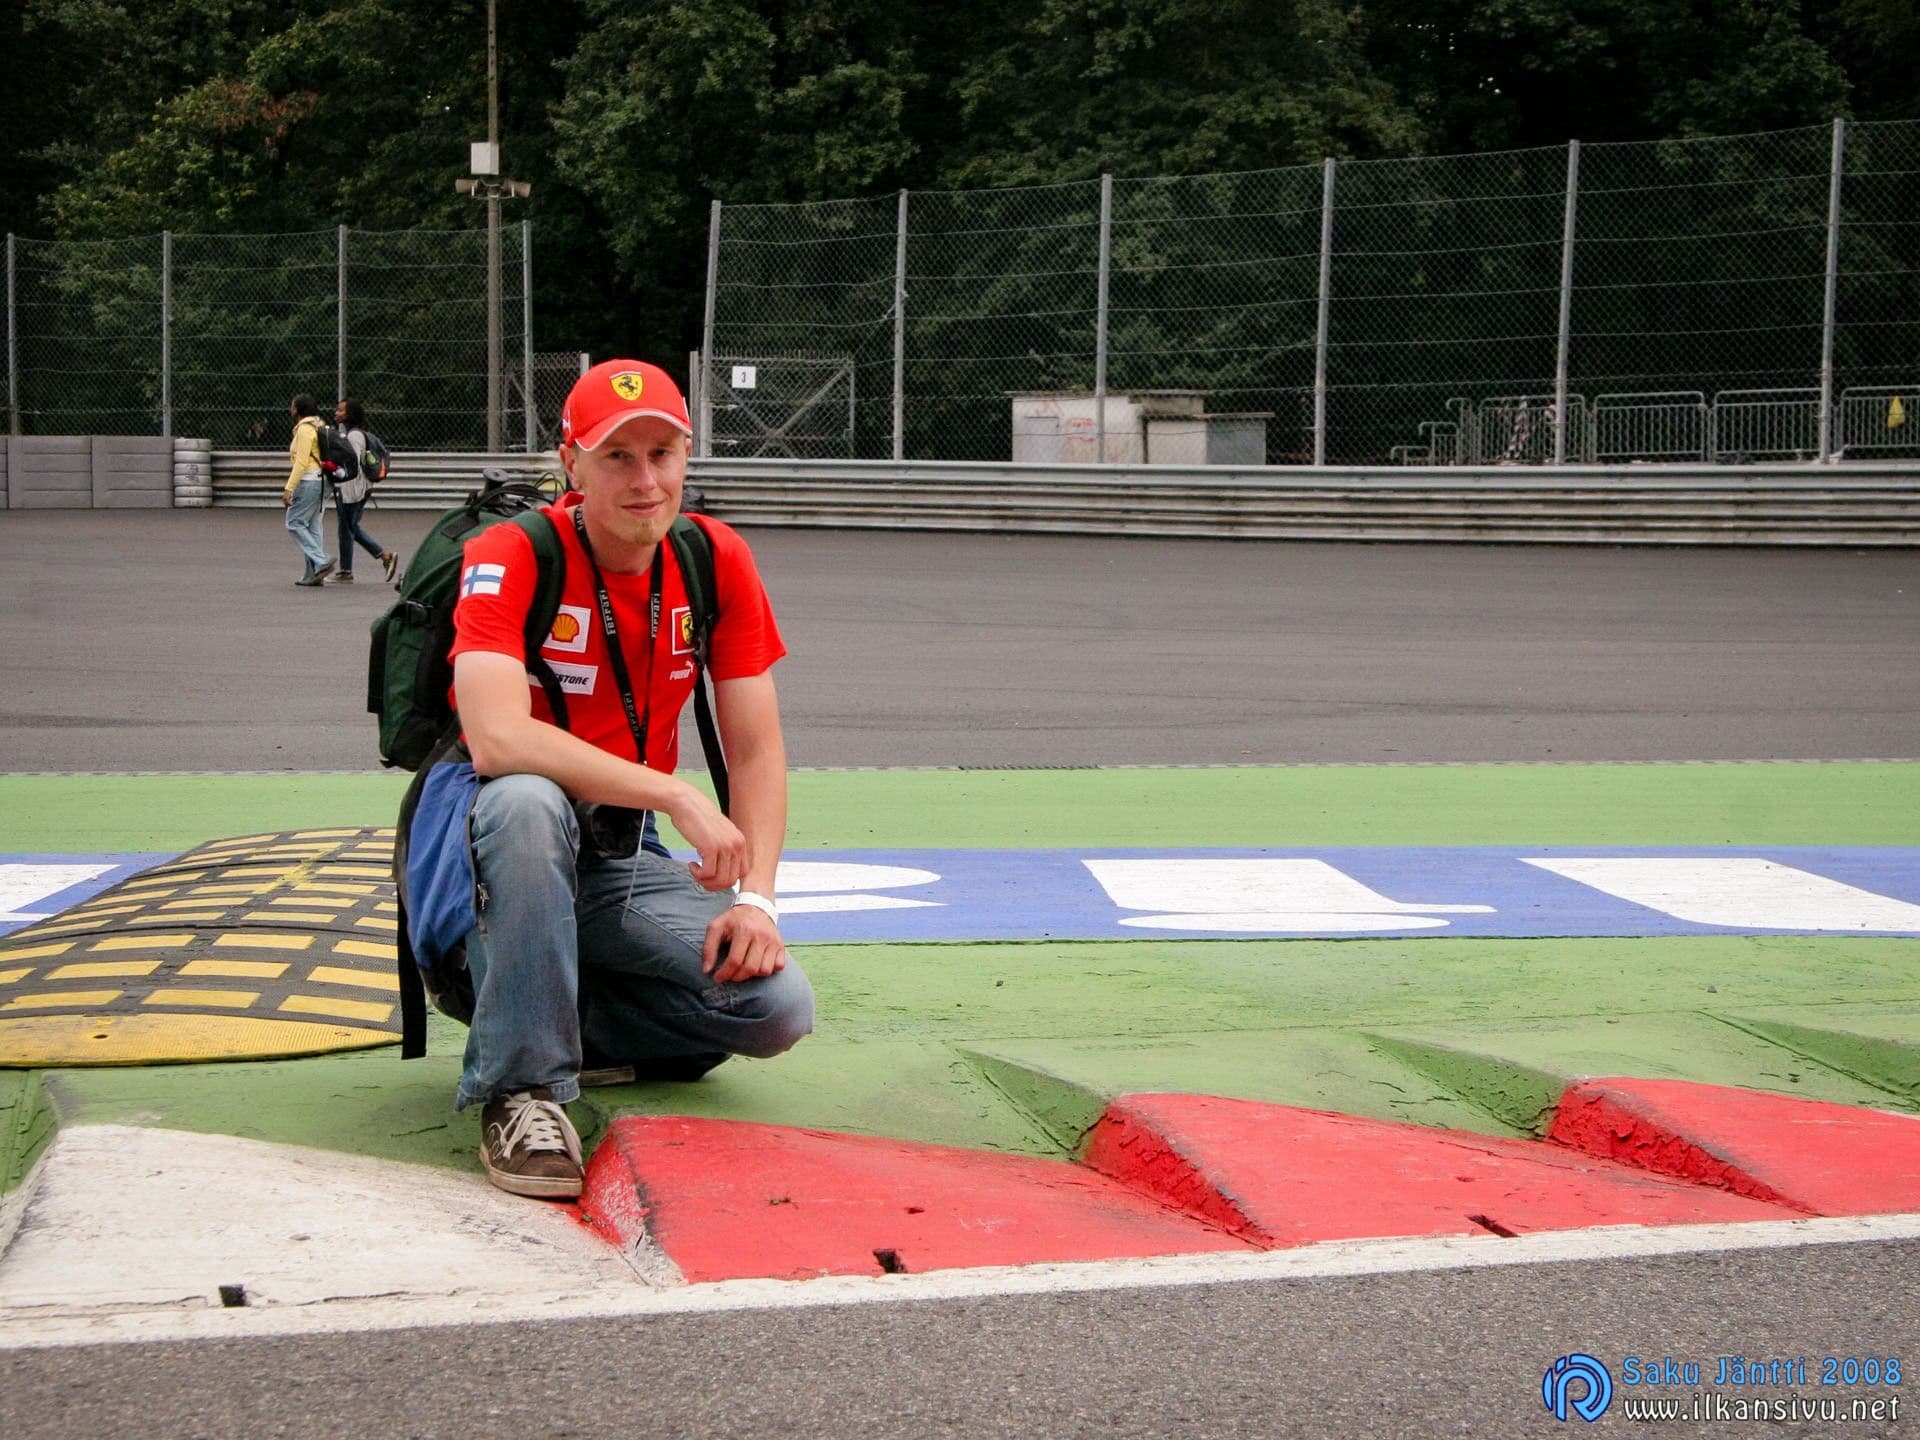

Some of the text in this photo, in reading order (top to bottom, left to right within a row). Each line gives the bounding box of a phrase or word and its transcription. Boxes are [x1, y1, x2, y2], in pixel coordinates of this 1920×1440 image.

[741, 371, 747, 383] 3
[600, 590, 616, 636] Ferrari
[555, 674, 590, 686] STONE
